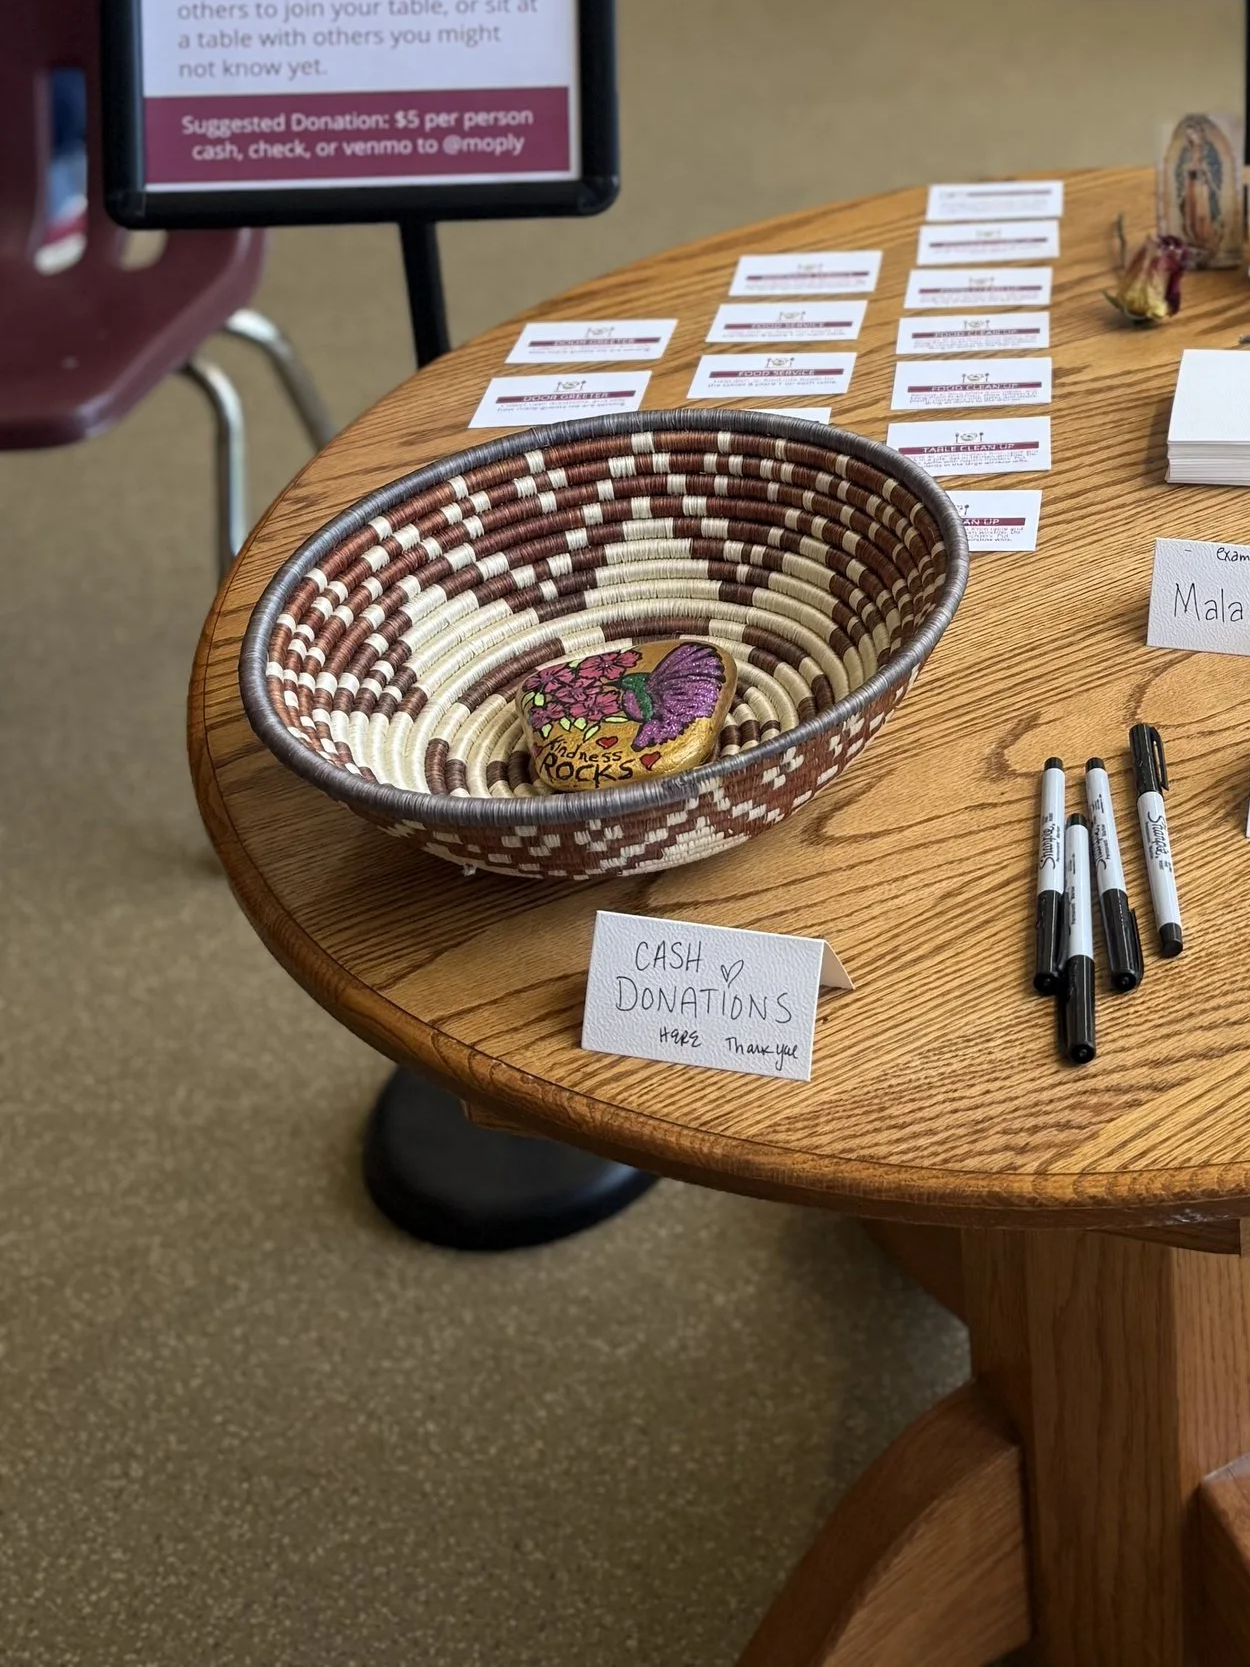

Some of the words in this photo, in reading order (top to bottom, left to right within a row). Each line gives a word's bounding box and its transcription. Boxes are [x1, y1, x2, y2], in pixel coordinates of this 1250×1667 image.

[181, 112, 286, 139] Suggested
[290, 111, 389, 132] Donation:
[394, 109, 420, 129] $5
[424, 112, 459, 132] per
[463, 109, 534, 131] person
[191, 140, 243, 161] cash,
[248, 139, 311, 159] check,
[315, 141, 338, 157] or
[342, 139, 413, 156] venmo
[416, 137, 439, 154] to
[442, 133, 525, 156] @moply
[523, 394, 557, 403] DOOR
[560, 392, 609, 401] GREETER
[966, 383, 1001, 391] CLEAN
[923, 446, 956, 454] TABLE
[960, 444, 996, 452] CLEAN
[539, 752, 635, 789] ROCKS
[635, 940, 703, 973] CASH
[615, 975, 793, 1024] DONATIONS
